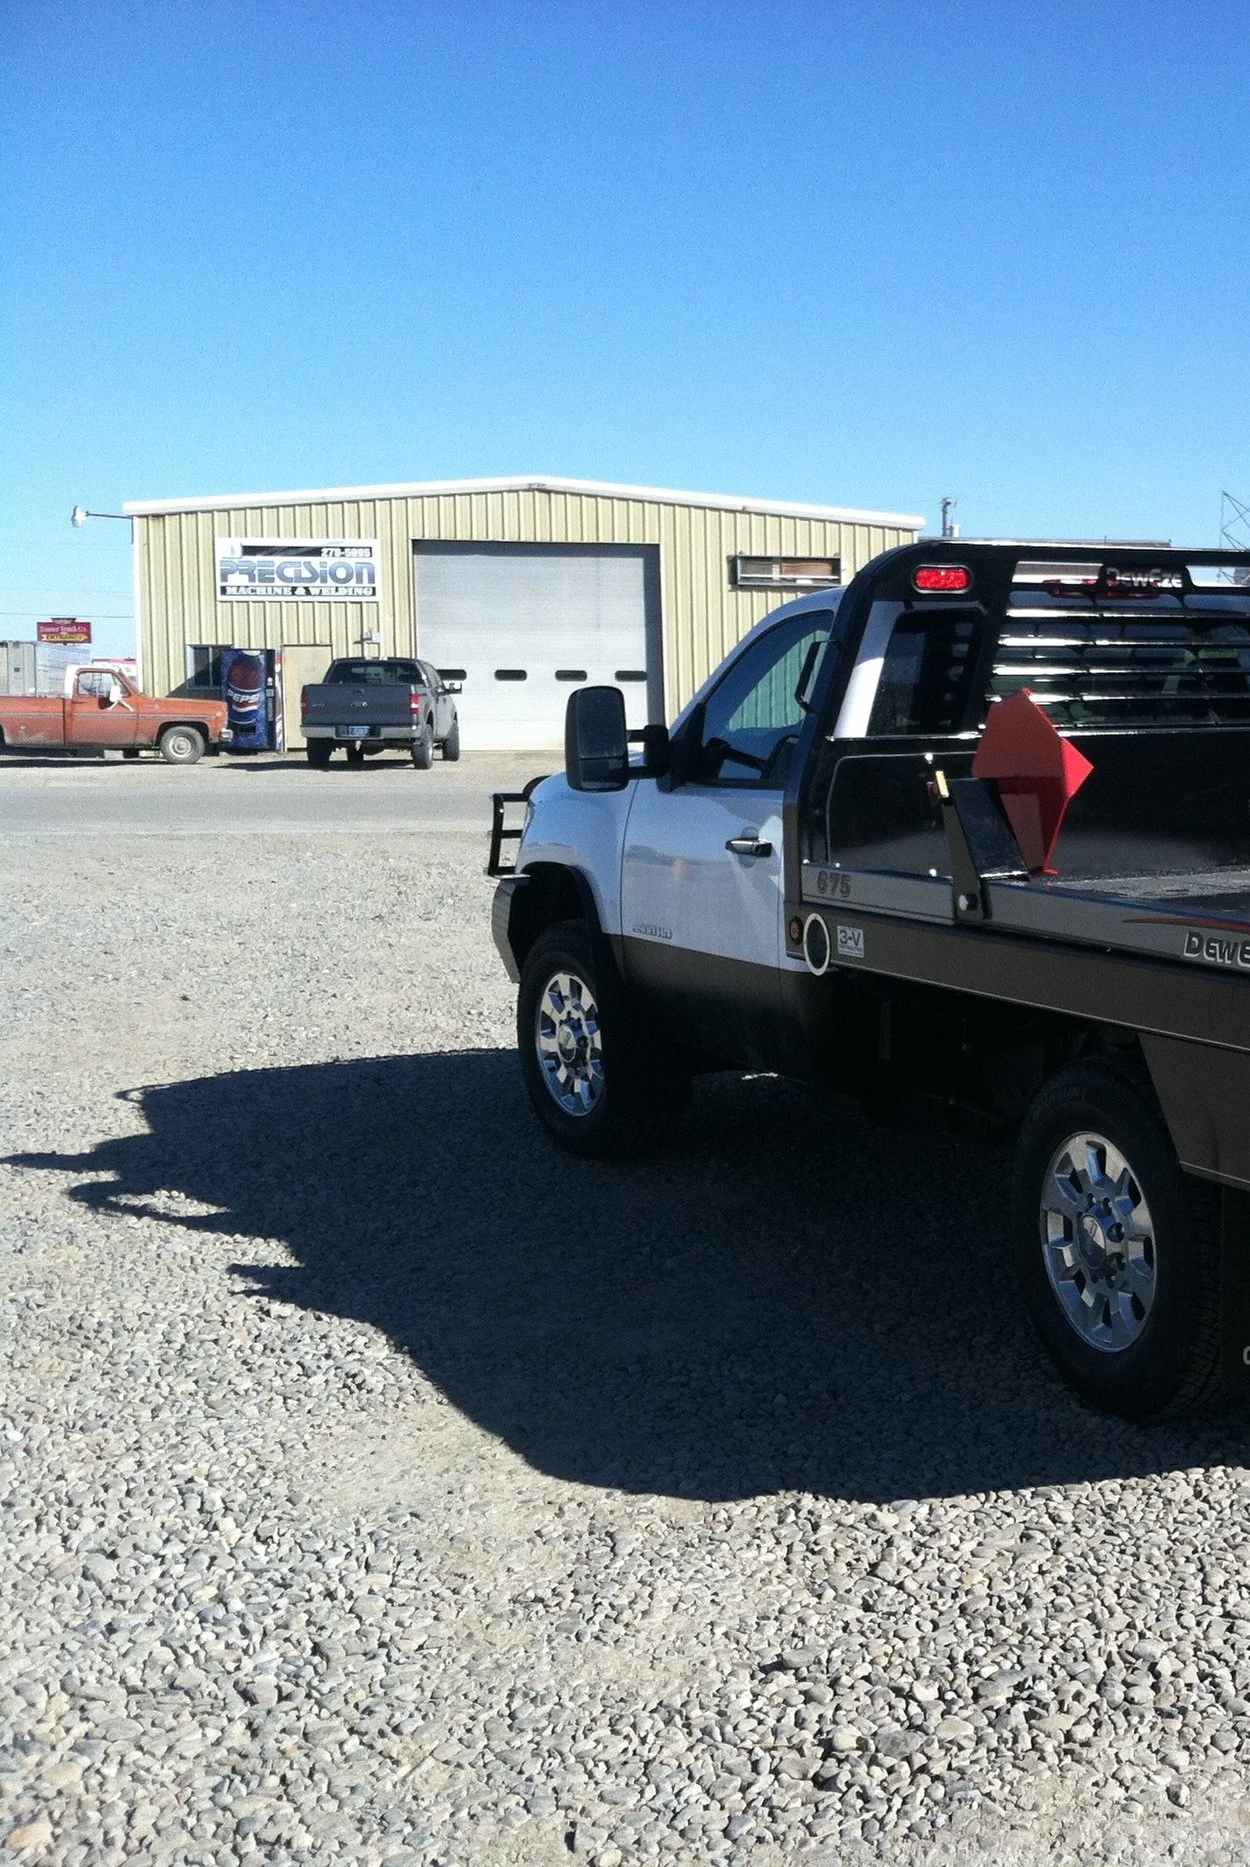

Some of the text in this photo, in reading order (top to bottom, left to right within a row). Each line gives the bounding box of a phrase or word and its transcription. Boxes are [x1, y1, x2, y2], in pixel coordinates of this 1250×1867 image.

[225, 585, 373, 596] MACHINE & WELDING
[816, 870, 852, 899] 675
[840, 929, 862, 947] 3-V
